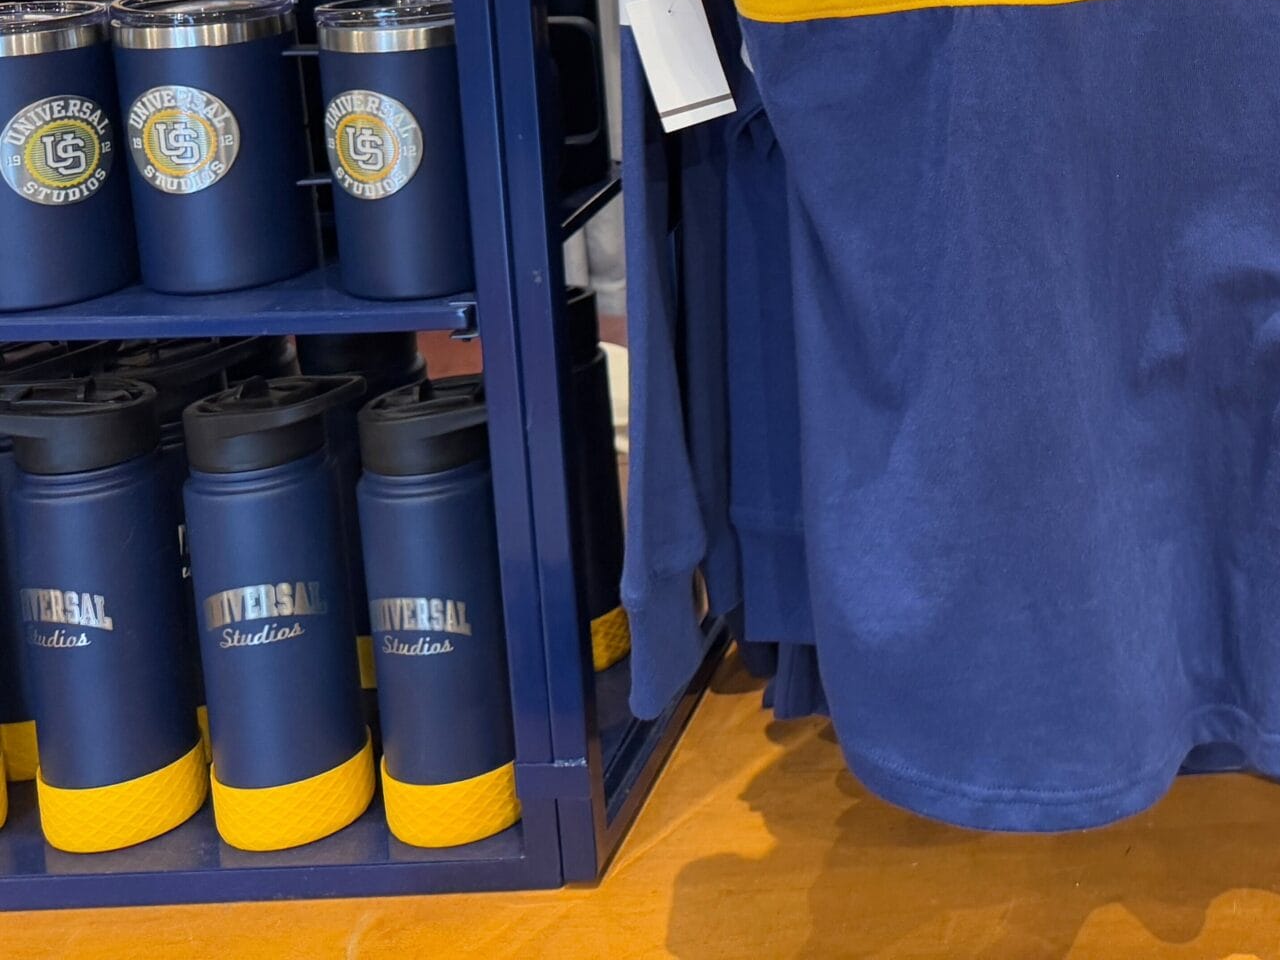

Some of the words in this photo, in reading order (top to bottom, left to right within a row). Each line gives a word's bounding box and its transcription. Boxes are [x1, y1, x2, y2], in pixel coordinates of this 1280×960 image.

[5, 99, 111, 146] UNIVERSAL
[129, 90, 232, 130] UNIVERSAL
[325, 94, 418, 139] UNIVERSAL
[7, 154, 22, 168] 19
[101, 140, 112, 154] 12
[220, 134, 234, 147] 12
[403, 144, 417, 157] 12
[22, 167, 107, 203] STUDIOS
[144, 160, 225, 191] STUDIOS
[335, 166, 408, 197] STUDIOS
[219, 622, 306, 650] Studios
[381, 636, 455, 657] Studios
